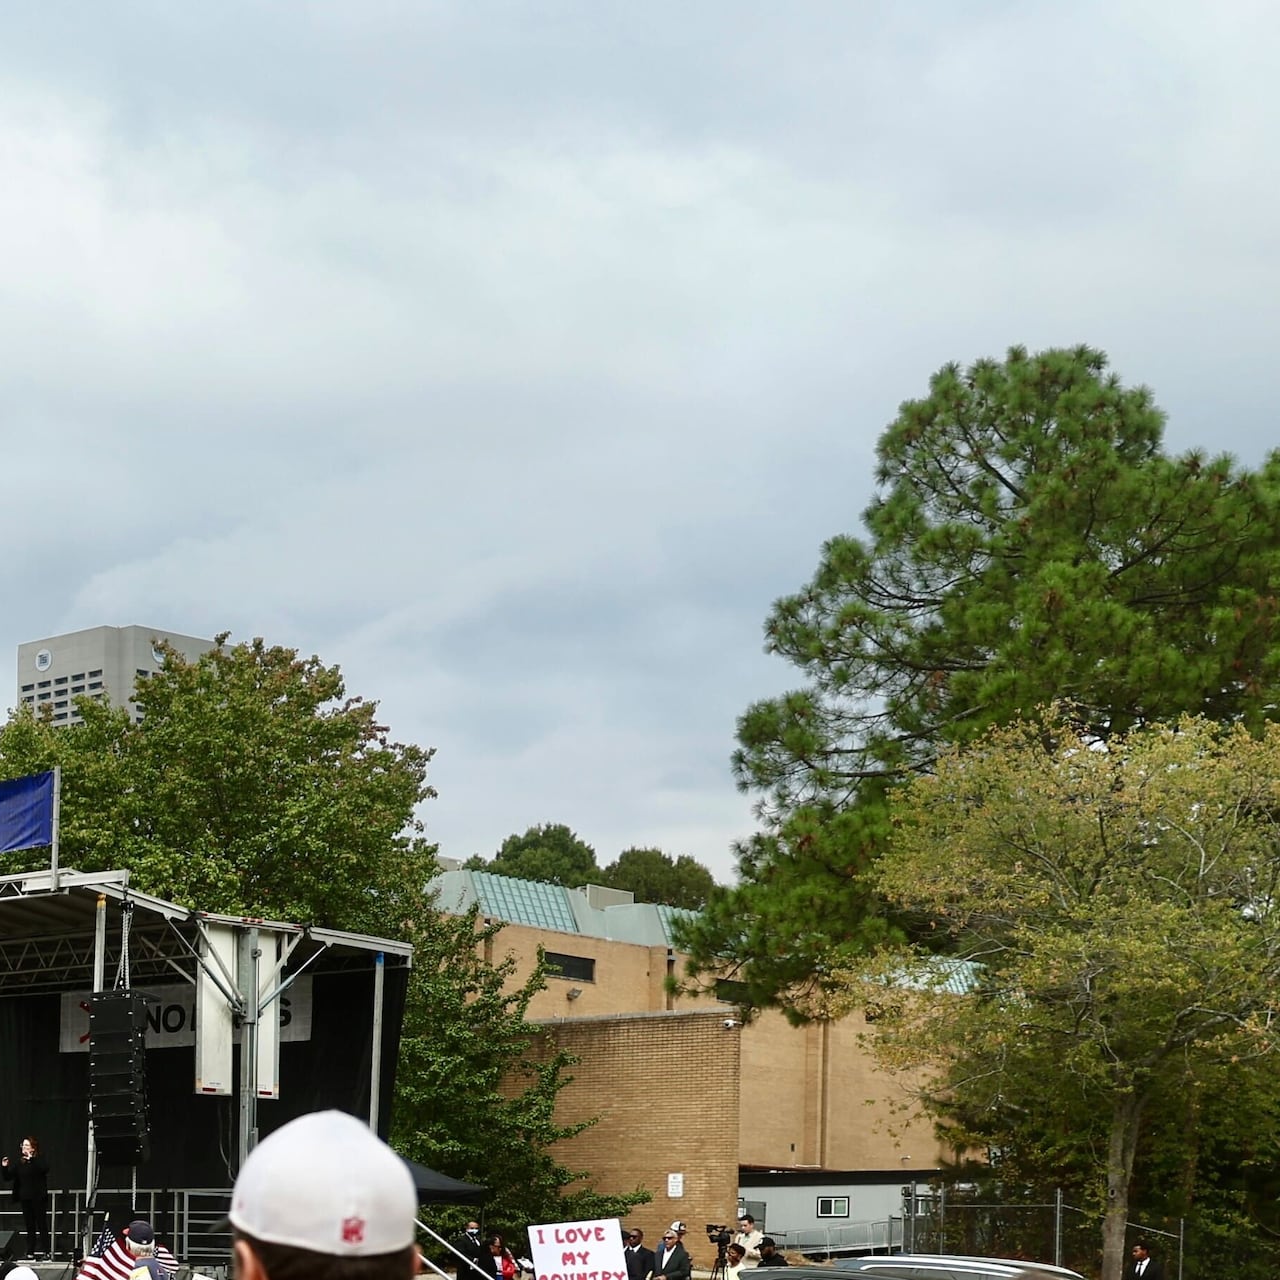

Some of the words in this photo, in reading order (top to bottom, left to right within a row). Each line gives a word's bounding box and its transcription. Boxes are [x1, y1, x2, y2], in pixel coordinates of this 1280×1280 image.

[536, 1229, 545, 1245] I
[554, 1227, 606, 1244] LOVE
[561, 1251, 591, 1266] MY
